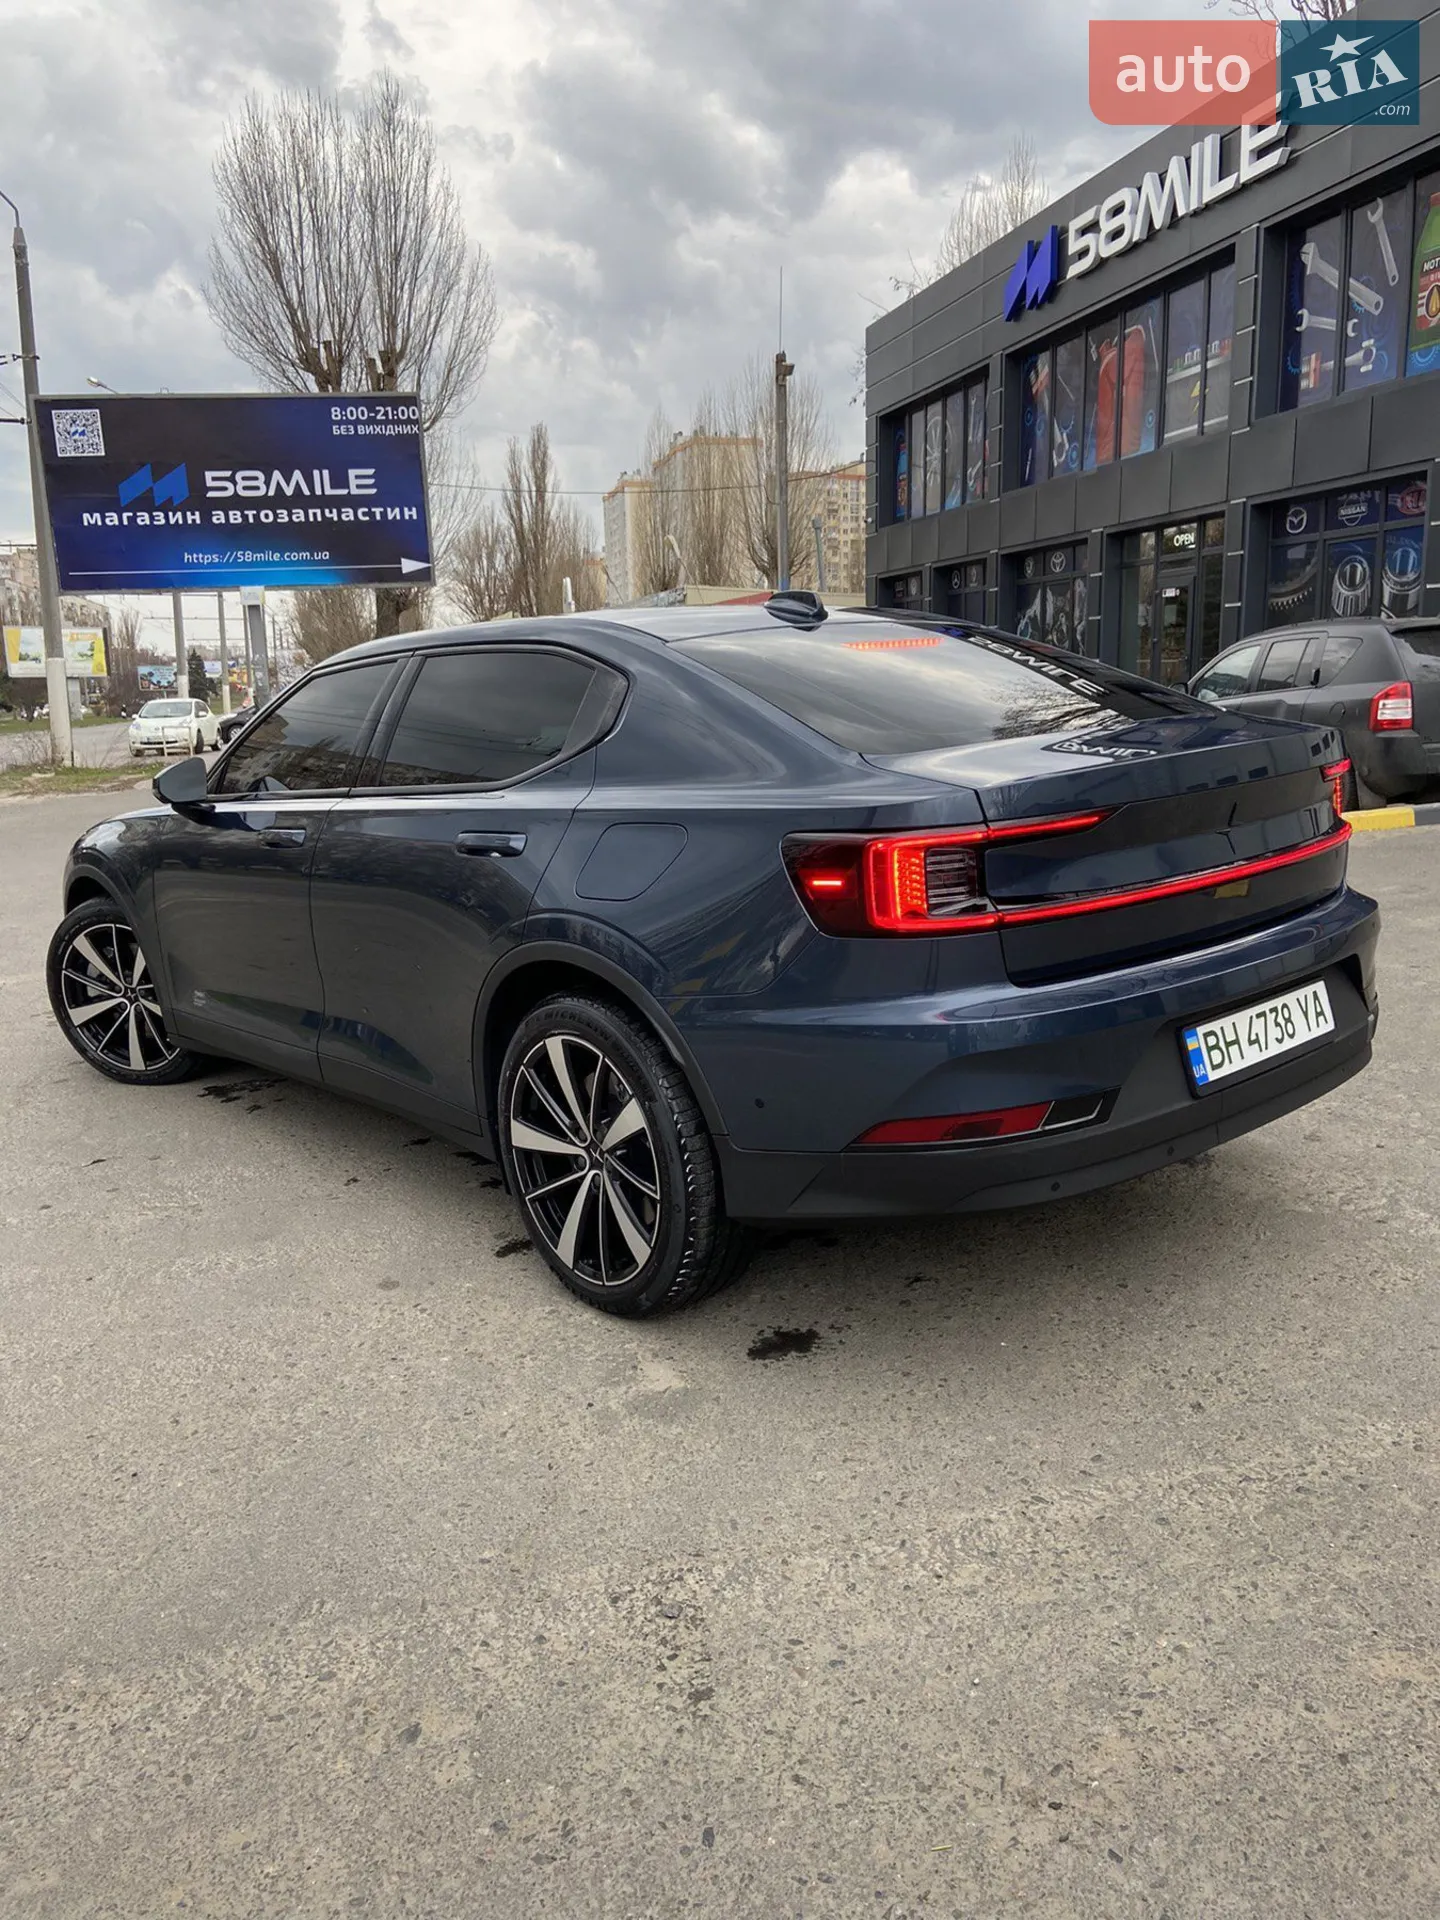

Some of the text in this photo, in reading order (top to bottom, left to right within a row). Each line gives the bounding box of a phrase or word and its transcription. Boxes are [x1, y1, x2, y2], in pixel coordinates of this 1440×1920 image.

[1066, 89, 1293, 280] 58MILE
[330, 405, 420, 421] 8:00-21:00
[332, 423, 420, 437] БЕЗ ВИХІДНИХ
[204, 468, 378, 498] 58MILE
[82, 506, 418, 527] магазин автозапчастин
[1173, 531, 1196, 548] OPEN
[183, 549, 331, 566] https://58mile.com.ua
[1202, 990, 1329, 1071] BH 4738 YA
[1192, 1064, 1207, 1078] UA
